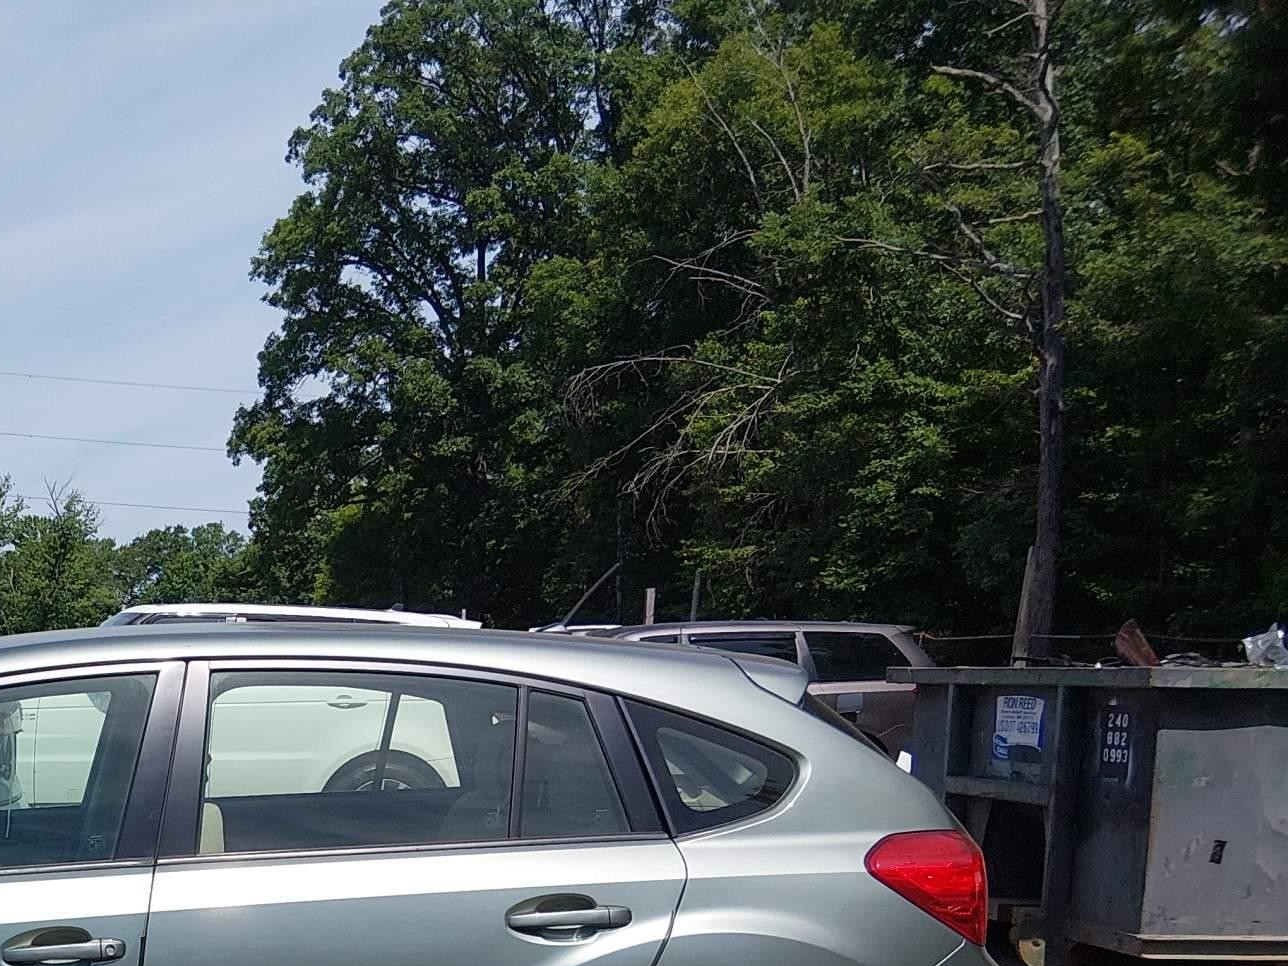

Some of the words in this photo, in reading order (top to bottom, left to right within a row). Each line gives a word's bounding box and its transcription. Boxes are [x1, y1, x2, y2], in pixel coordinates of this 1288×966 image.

[1019, 697, 1037, 710] REED
[1107, 713, 1129, 728] 240
[1106, 731, 1127, 746] 882
[1103, 748, 1128, 763] 0993
